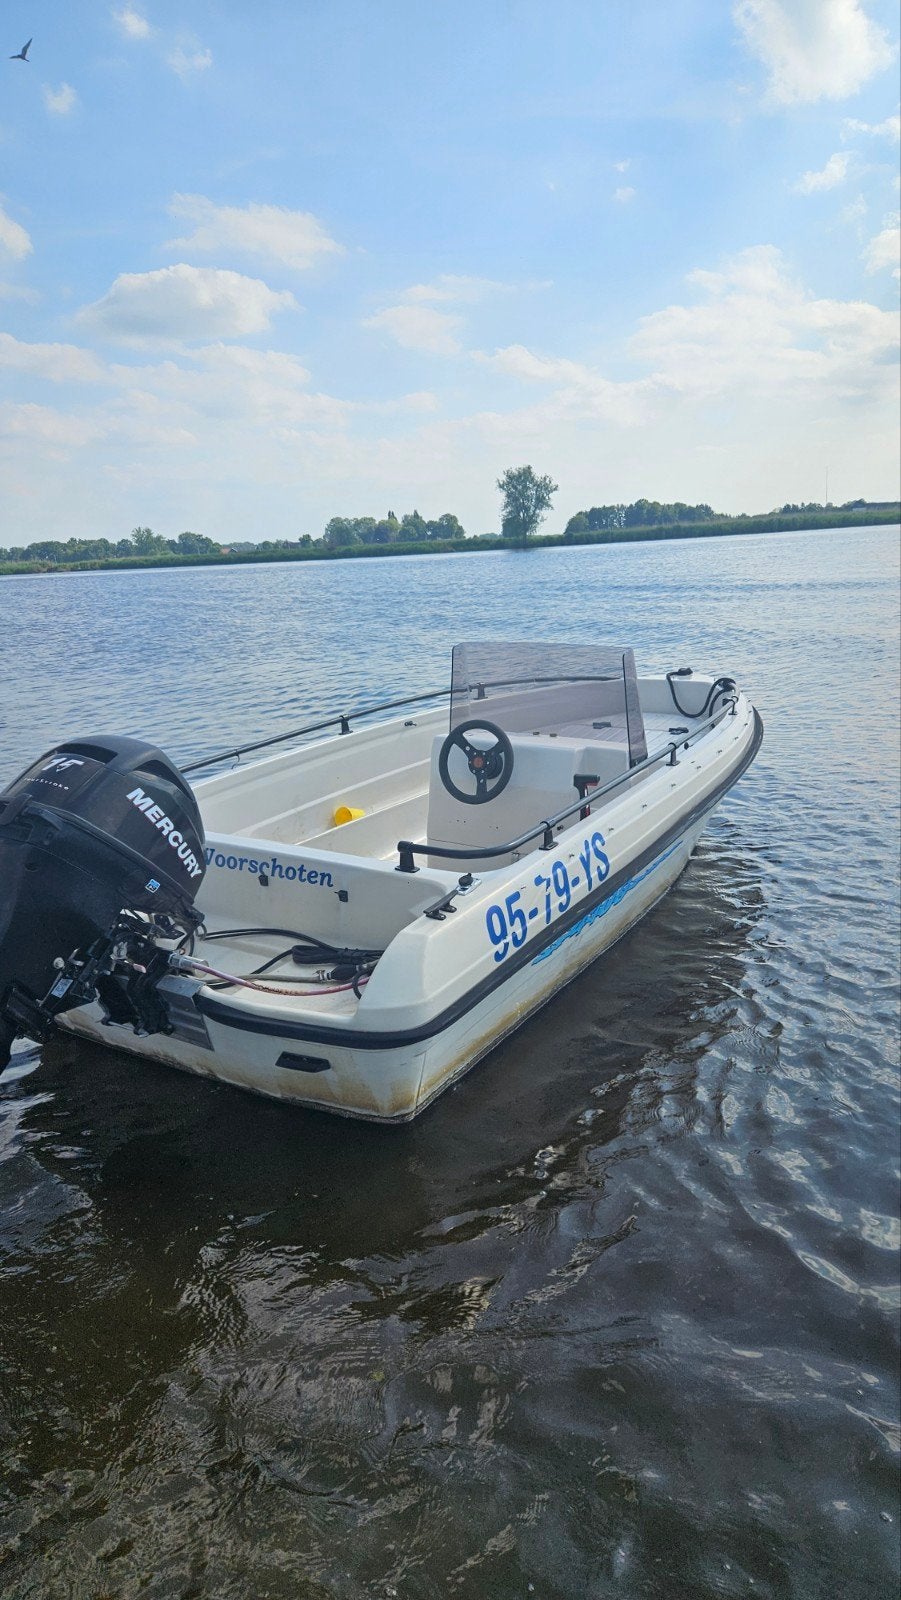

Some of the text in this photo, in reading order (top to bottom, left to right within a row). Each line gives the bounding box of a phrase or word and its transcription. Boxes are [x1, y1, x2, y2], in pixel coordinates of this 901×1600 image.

[126, 787, 202, 878] MERCURY
[205, 847, 334, 887] Voorschoten
[486, 832, 610, 962] 95-79-YS
